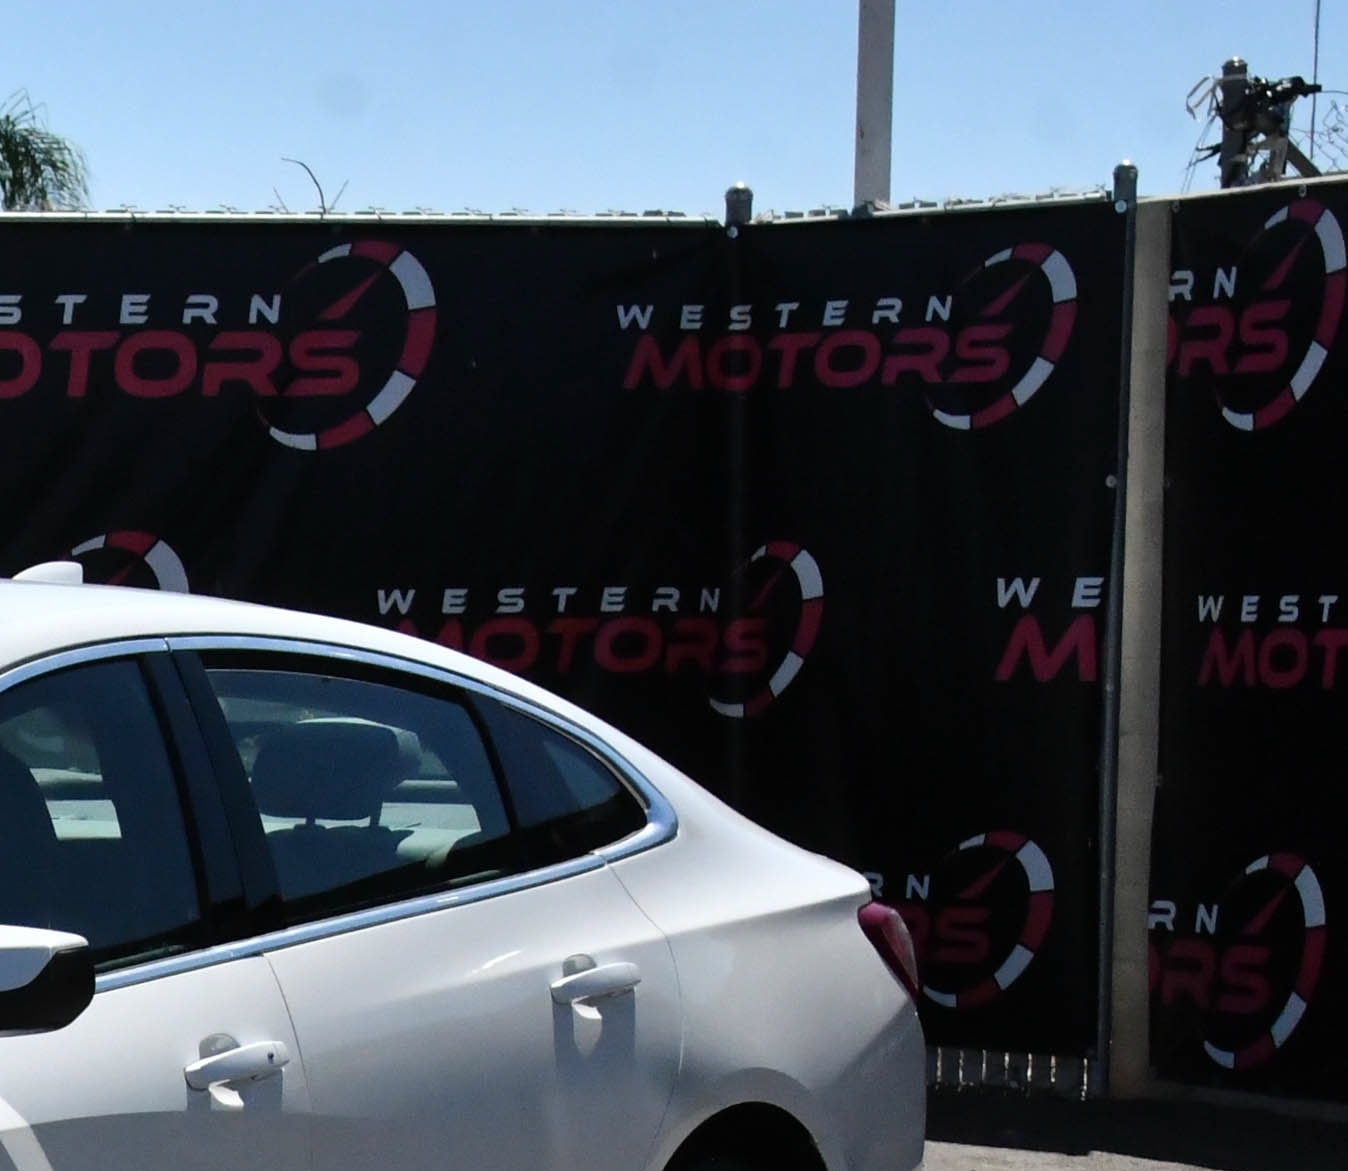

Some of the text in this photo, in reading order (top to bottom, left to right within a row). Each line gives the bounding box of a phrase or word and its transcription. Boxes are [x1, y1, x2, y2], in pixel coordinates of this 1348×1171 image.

[617, 294, 953, 331] WESTERN
[623, 323, 1013, 391] MOTORS
[377, 585, 721, 615] WESTERN
[1196, 593, 1340, 624] WEST
[394, 614, 770, 674] OTORS
